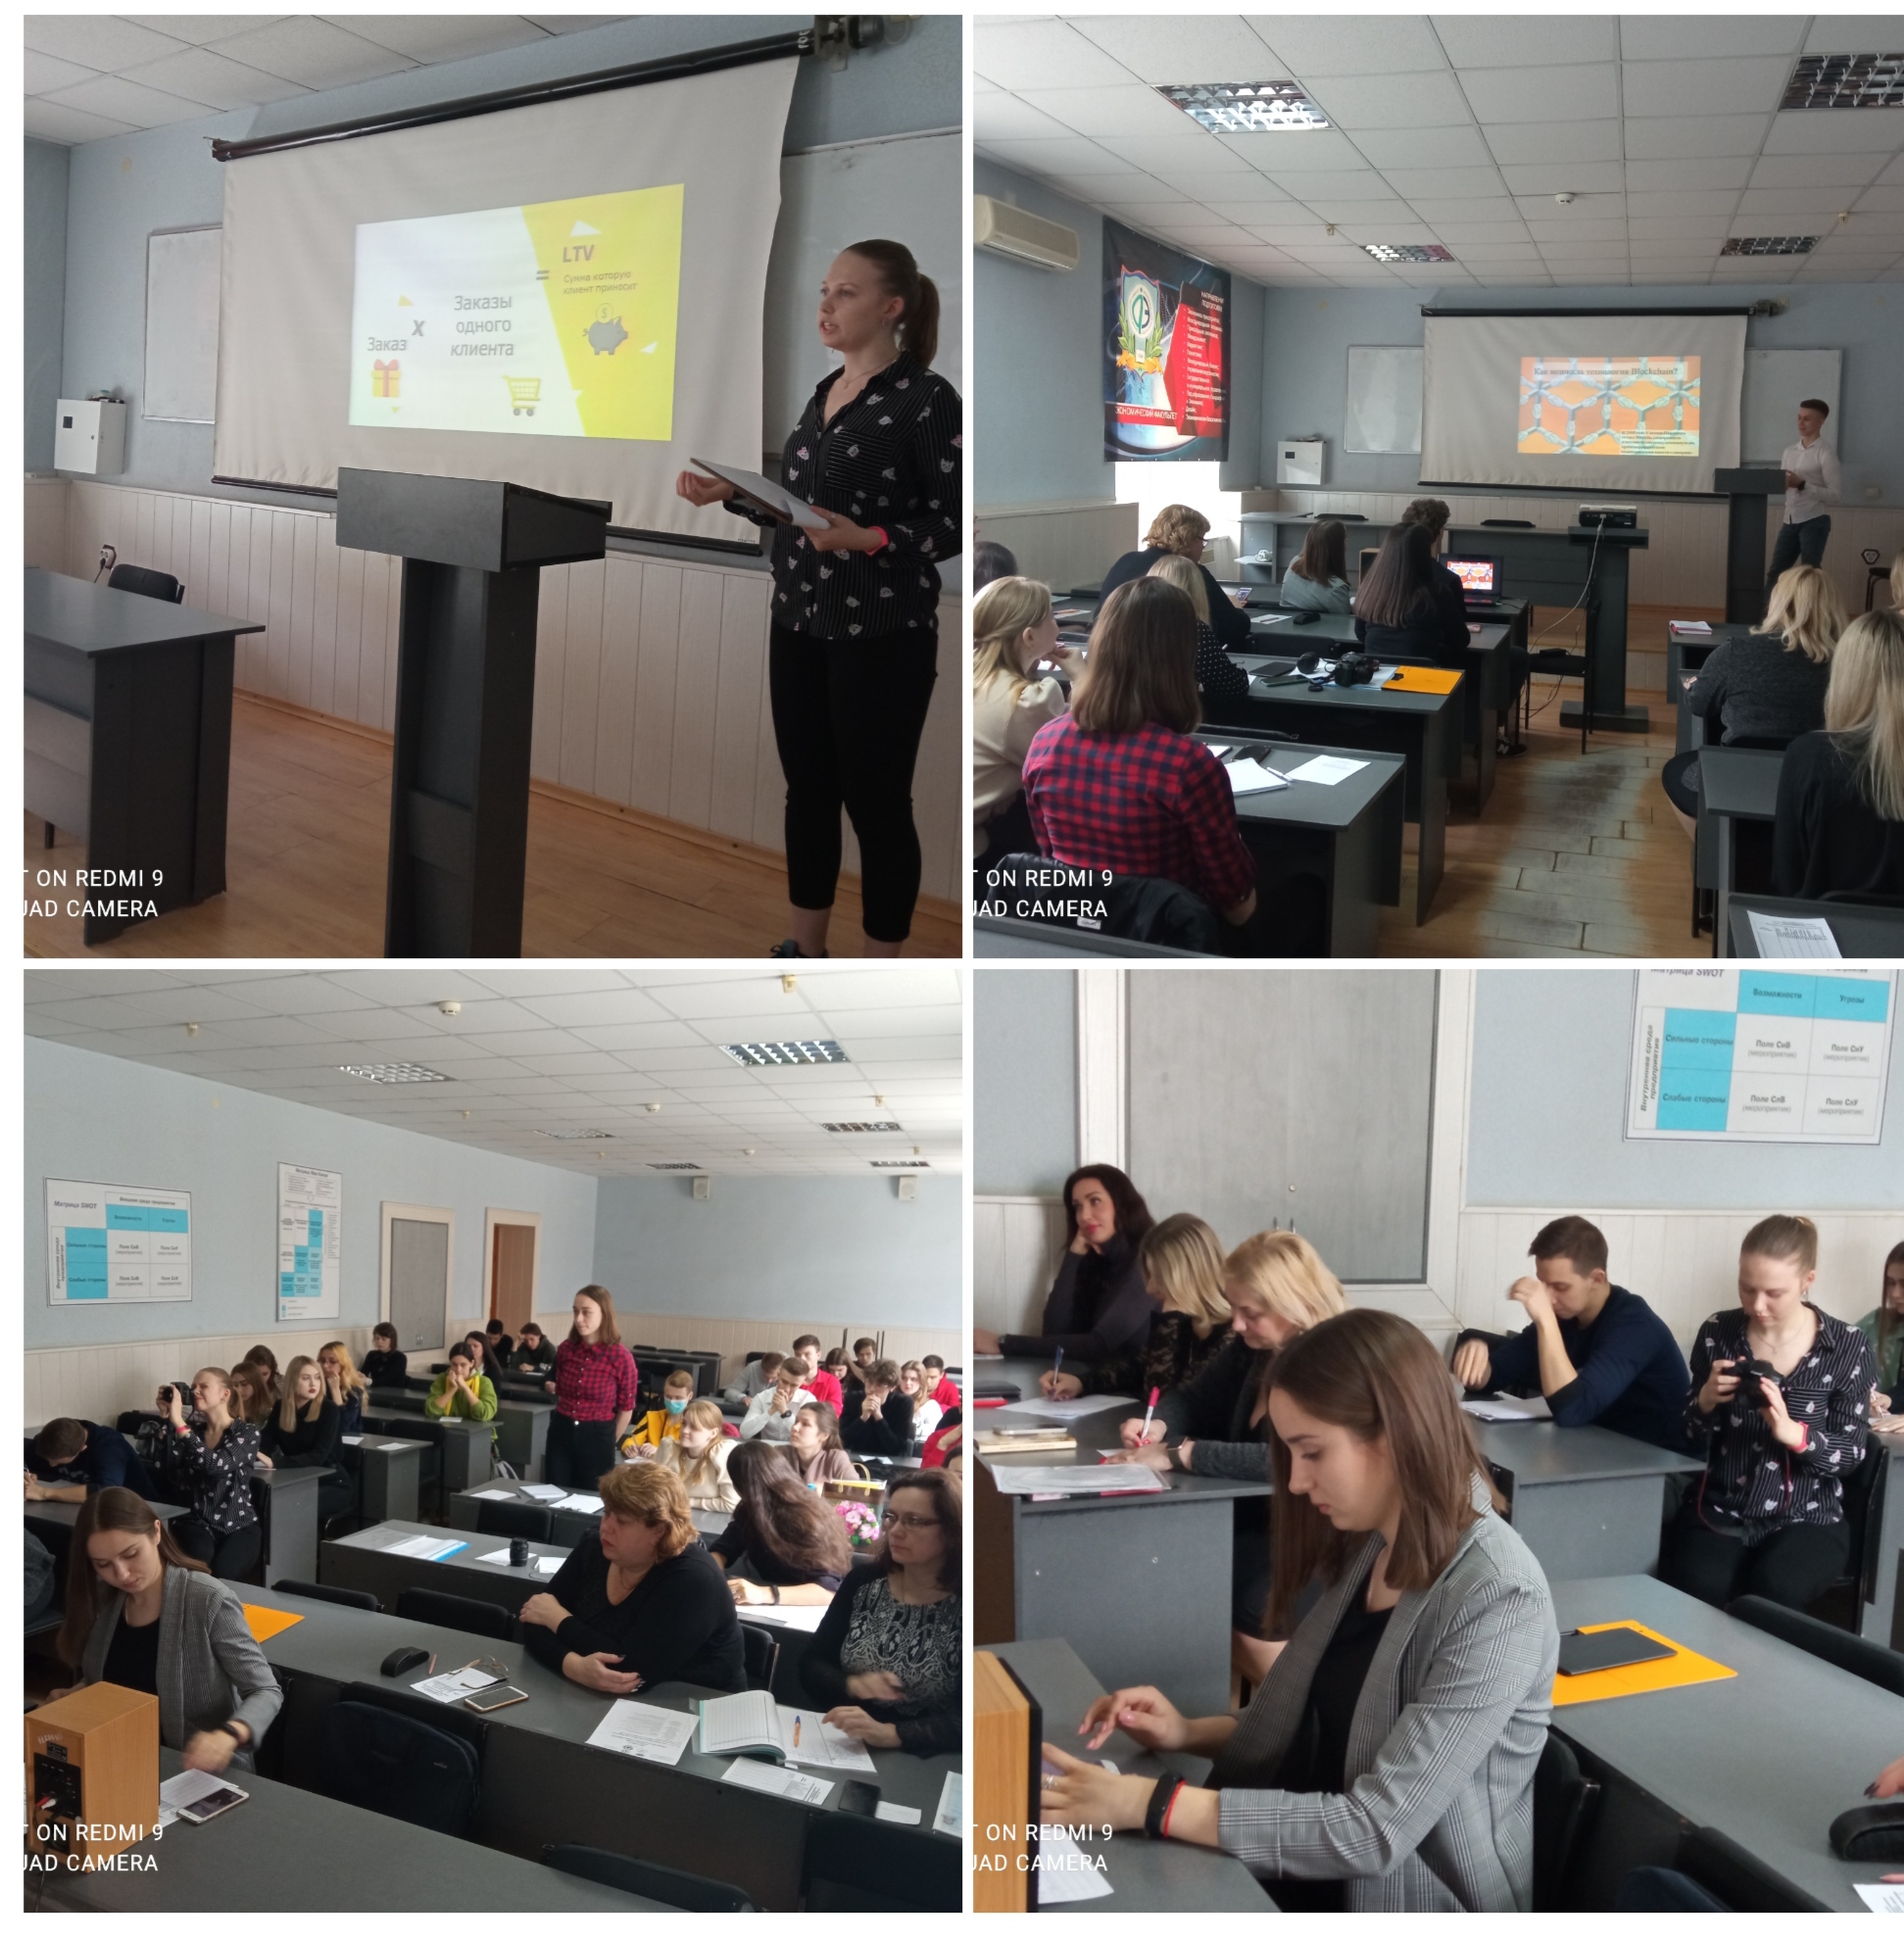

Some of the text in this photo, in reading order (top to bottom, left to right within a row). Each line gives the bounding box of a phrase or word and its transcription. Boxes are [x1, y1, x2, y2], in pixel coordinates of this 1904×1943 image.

[562, 244, 595, 263] LTV
[563, 271, 631, 284] Сумма которую
[563, 283, 637, 294] клиент приносит
[454, 295, 513, 311] Заказы
[456, 319, 512, 335] одного
[366, 336, 408, 352] Заказ
[451, 342, 514, 357] клиента
[1752, 988, 1802, 999] Возможности
[1839, 995, 1865, 1004] Угрозы
[1665, 1034, 1733, 1046] Сильные стороны
[1755, 1040, 1775, 1048] Поле
[1831, 1044, 1849, 1052] Поле
[1650, 1038, 1660, 1099] предприятия
[1640, 1056, 1650, 1112] Внутренняя
[1662, 1093, 1726, 1104] Слабые стороны
[1750, 1094, 1770, 1103] Поле
[1825, 1097, 1843, 1106] Поле
